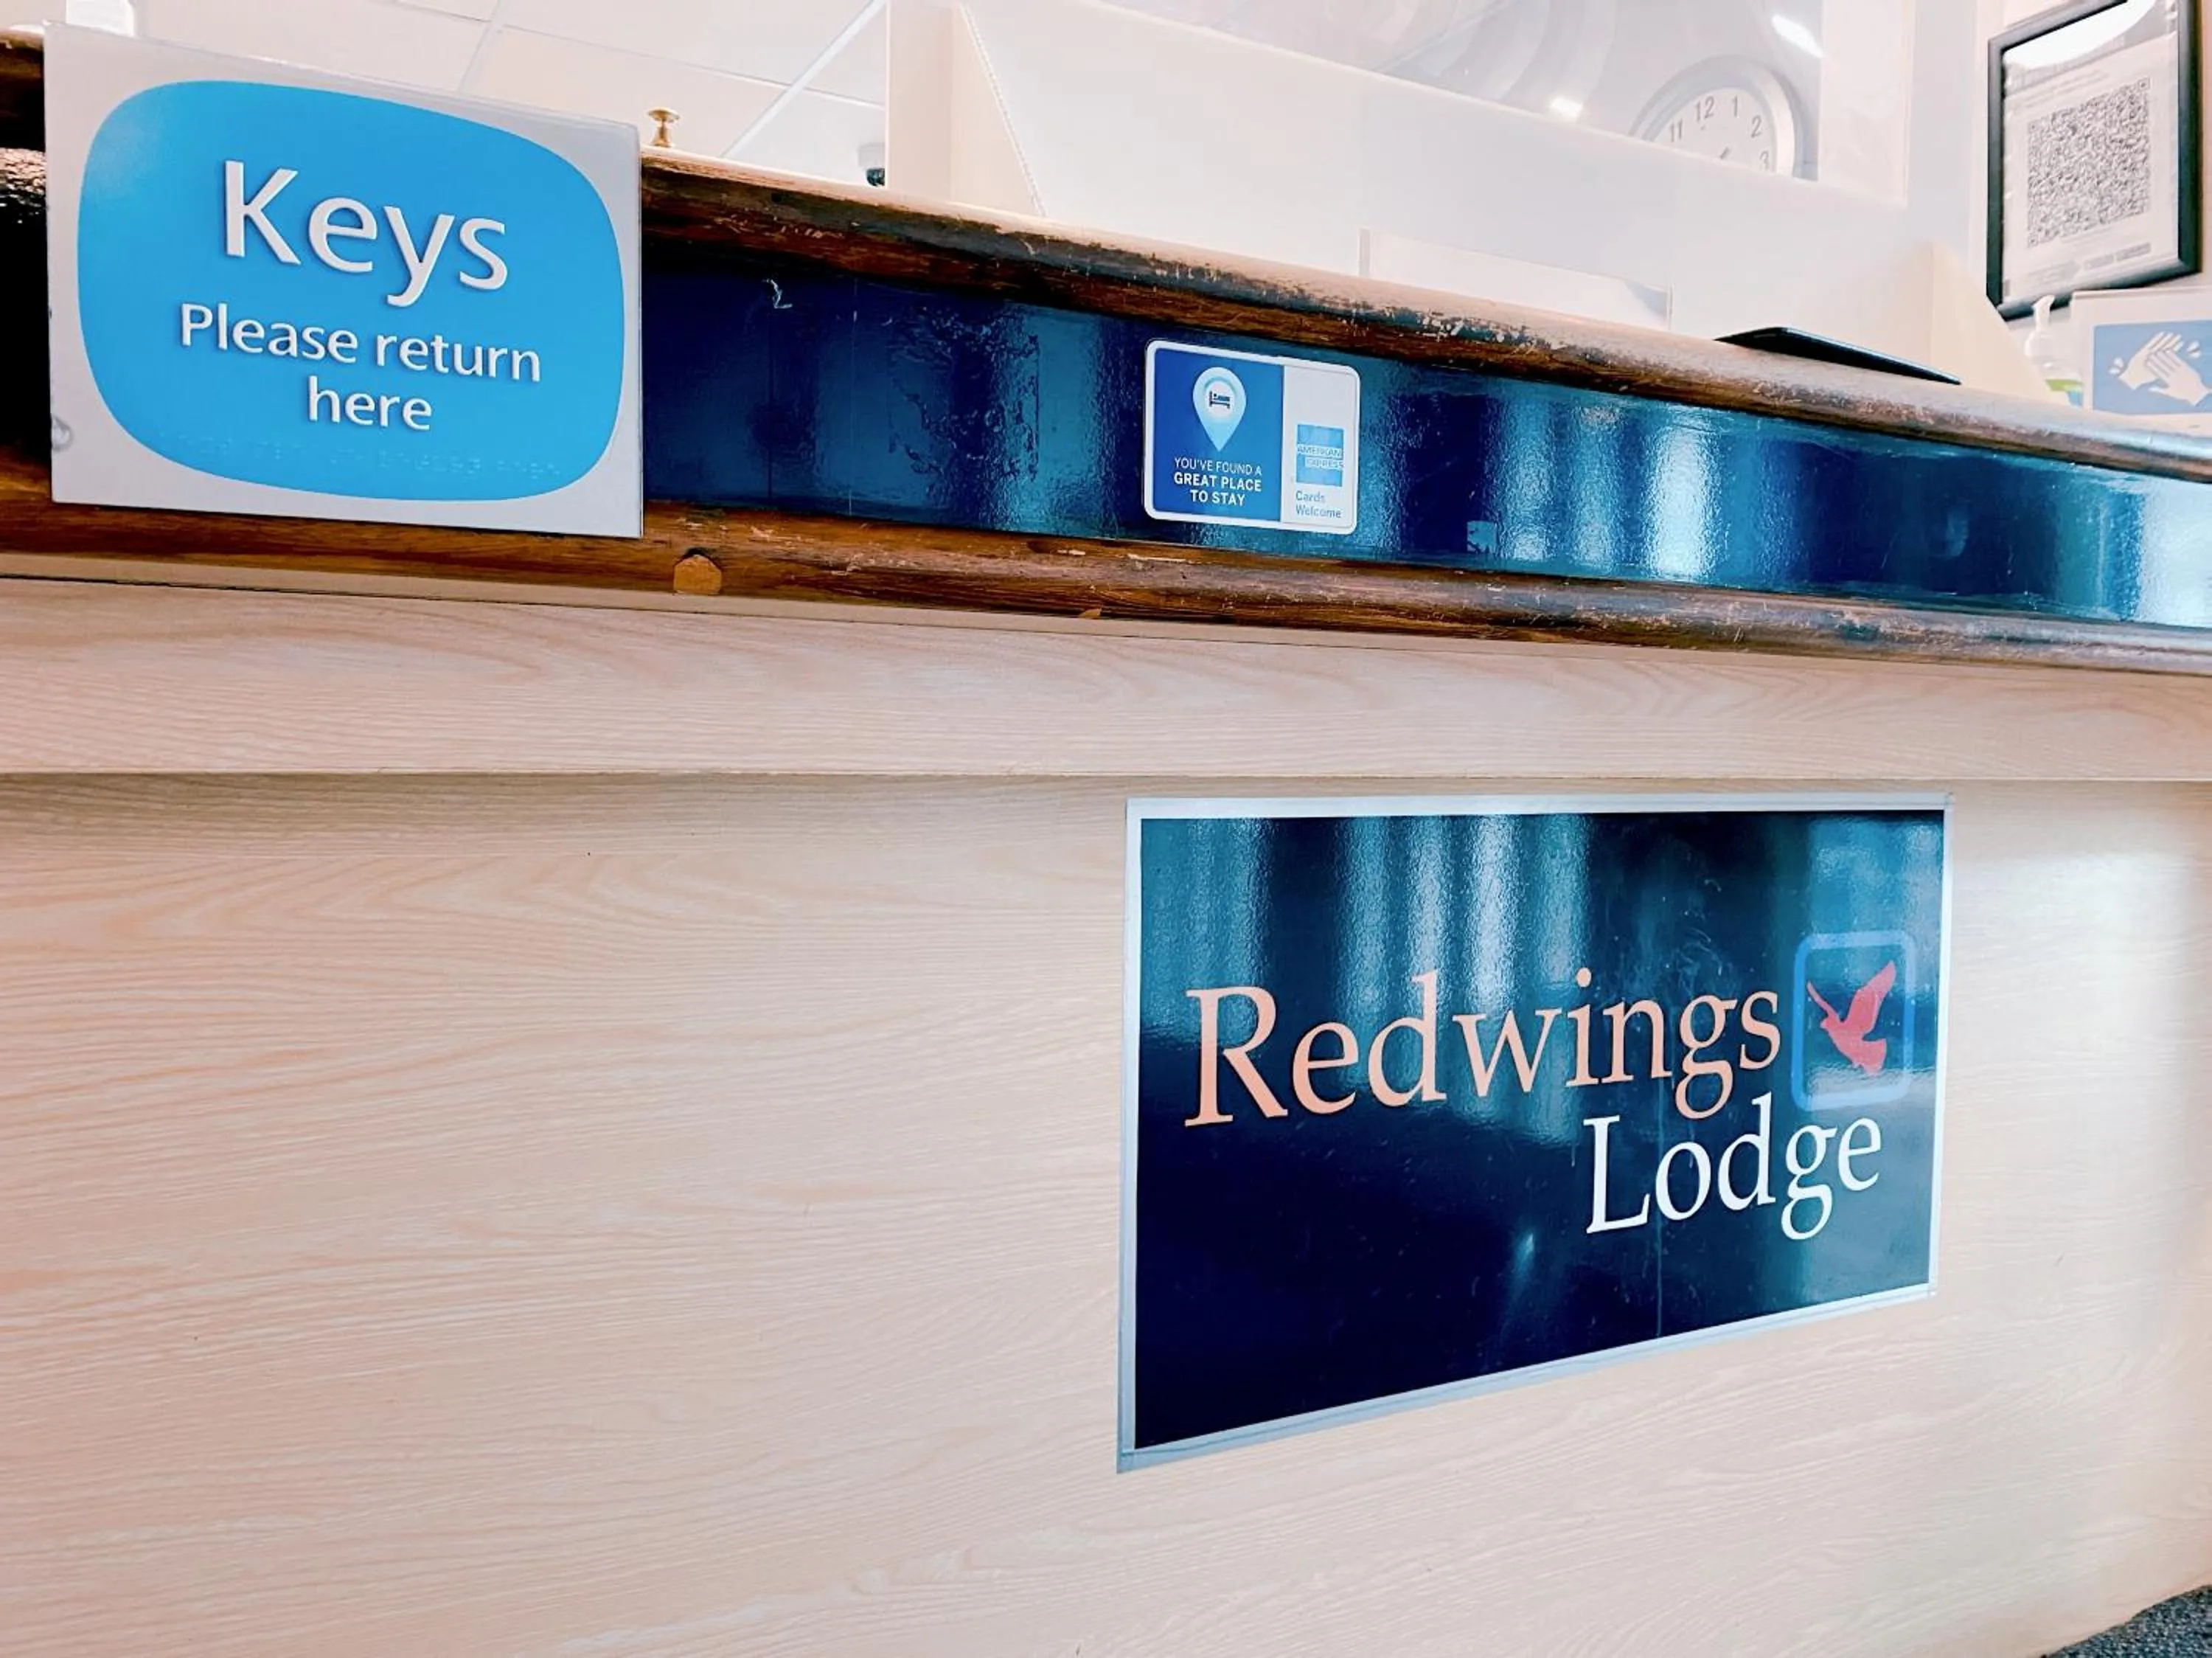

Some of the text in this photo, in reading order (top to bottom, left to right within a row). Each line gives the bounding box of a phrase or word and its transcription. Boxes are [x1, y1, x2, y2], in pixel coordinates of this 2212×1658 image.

[1695, 95, 1715, 122] 12
[1733, 94, 1739, 118] 1
[1669, 118, 1683, 143] 11
[1750, 114, 1762, 139] 2
[1759, 150, 1770, 171] 3
[222, 159, 509, 308] Keys
[179, 302, 541, 382] Please return
[308, 375, 433, 431] here
[1174, 457, 1262, 476] YOU'VE FOUND A
[1174, 471, 1262, 492] GREAT PLACE
[1189, 489, 1245, 507] TO STAY
[1295, 490, 1326, 502] Cards
[1295, 504, 1342, 518] Welcome
[1183, 967, 1781, 1127] Redwings
[1583, 1093, 1882, 1240] Lodge
